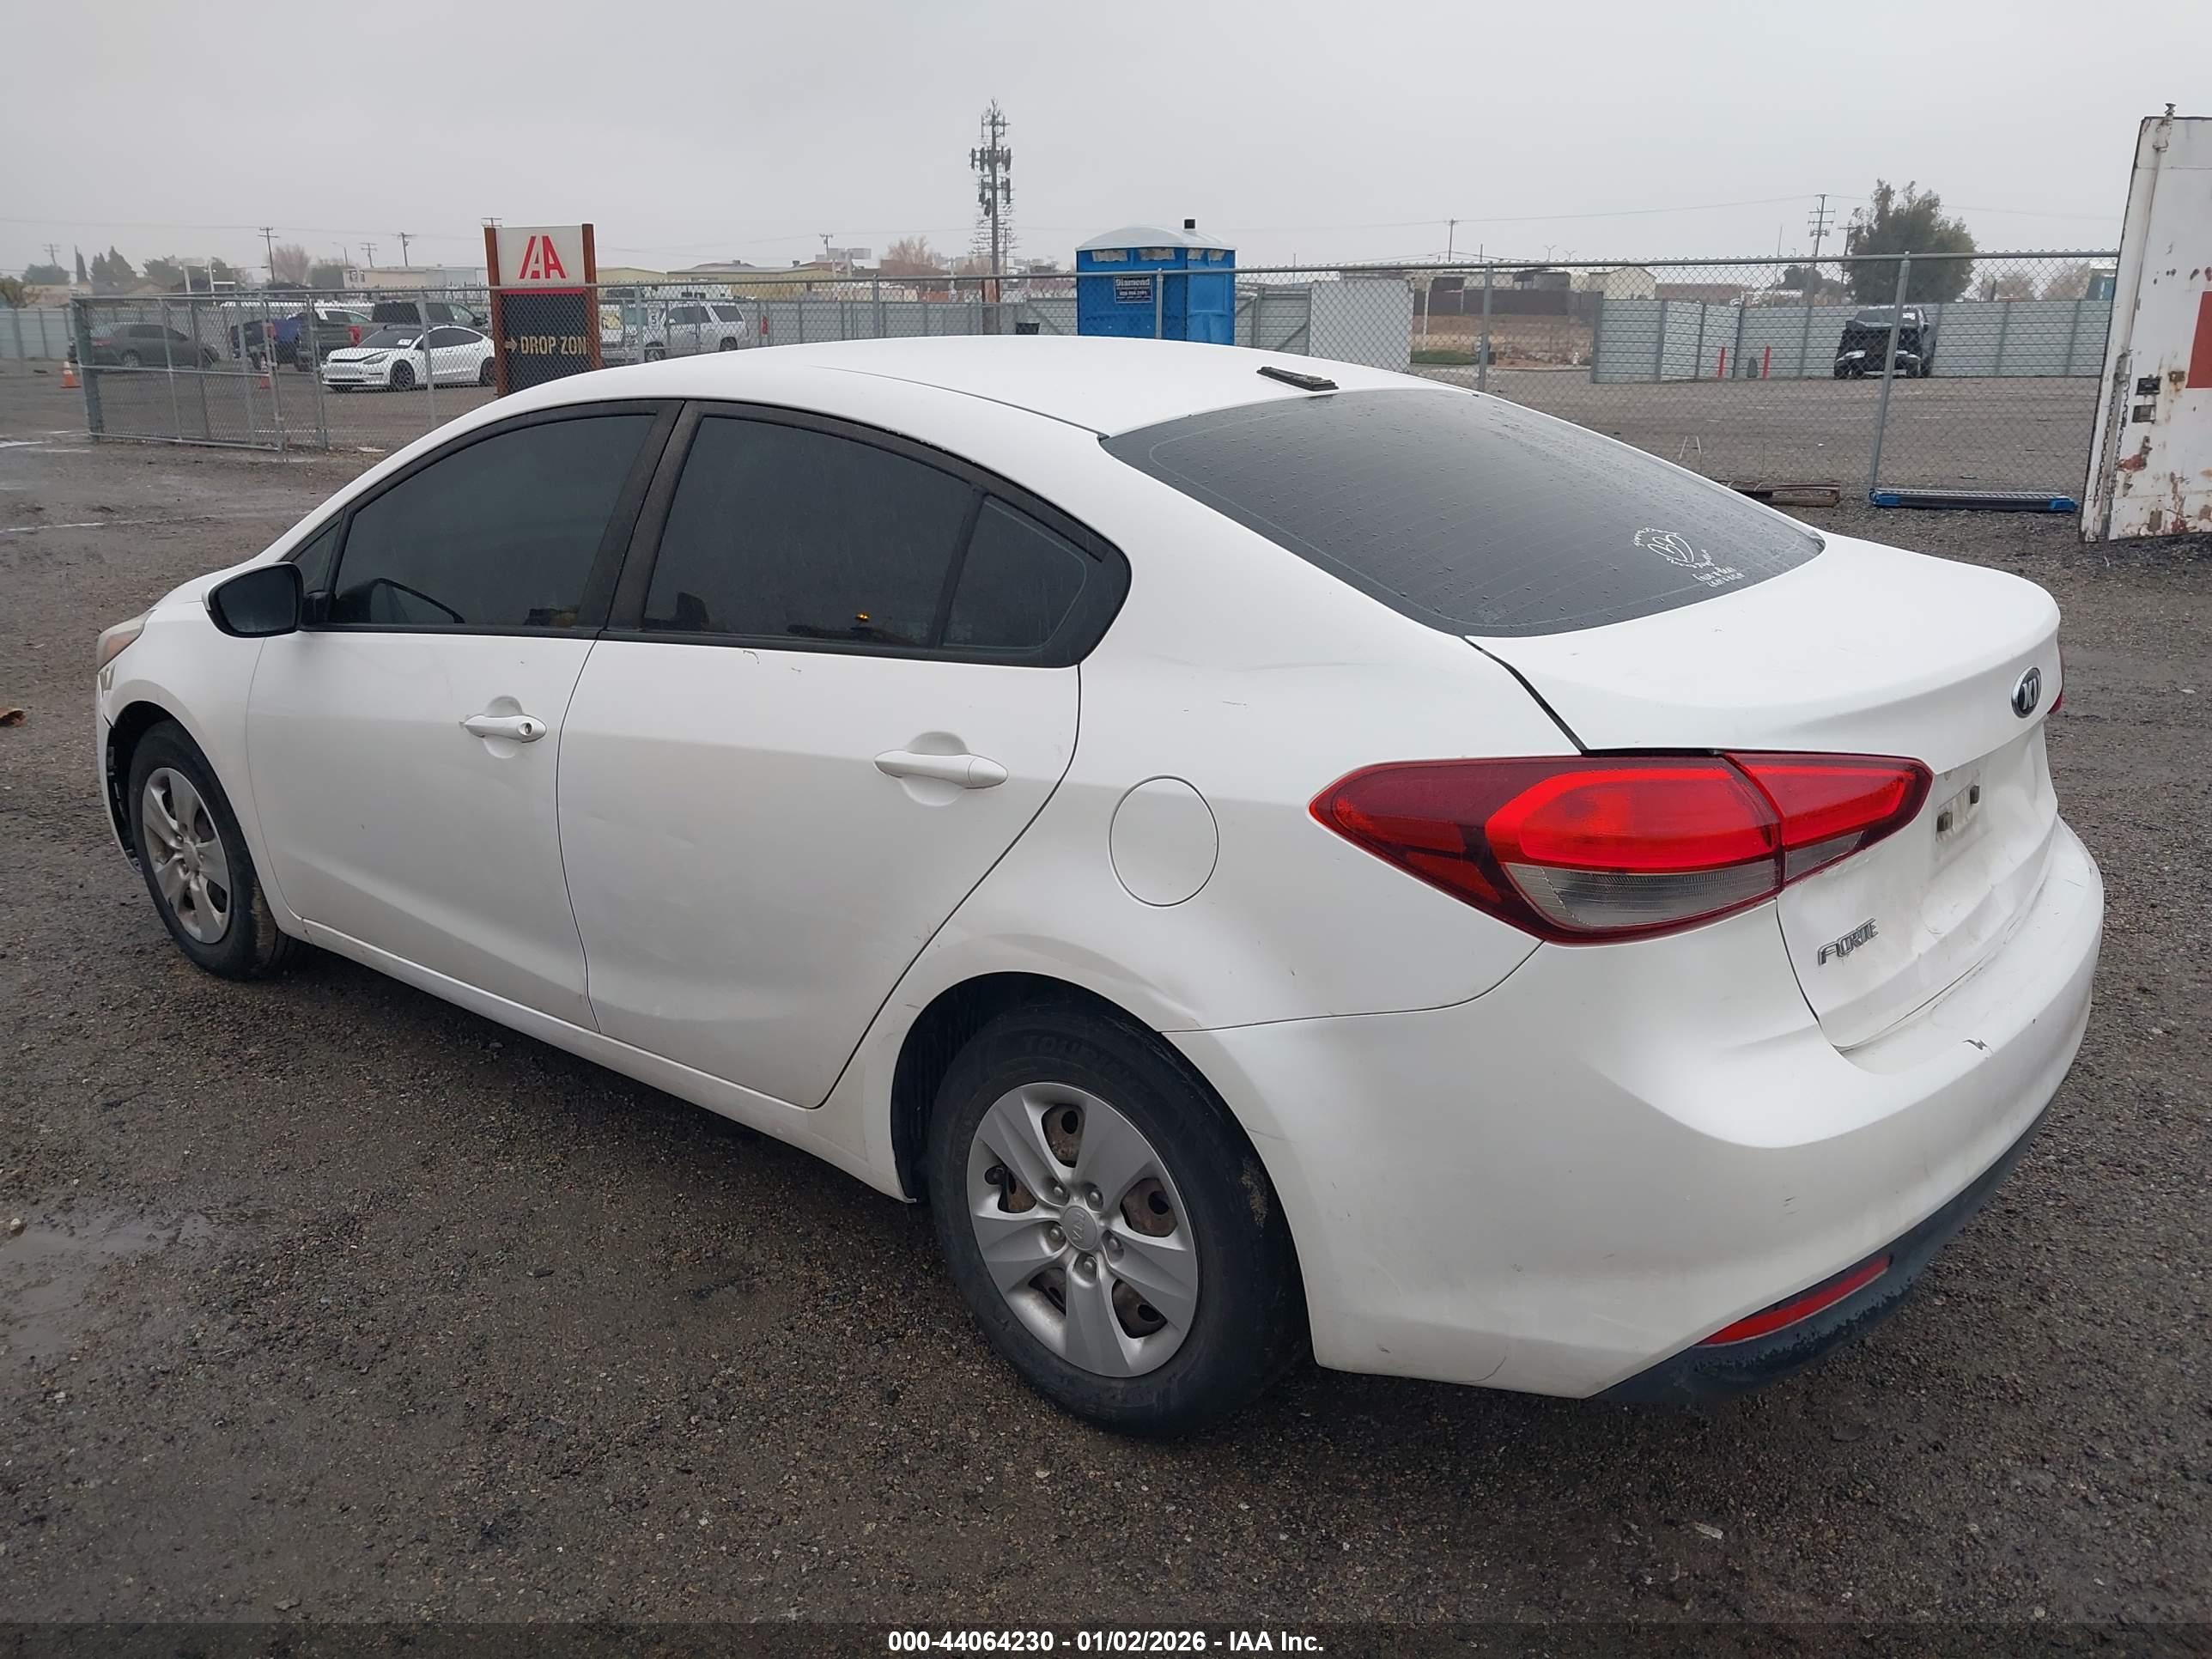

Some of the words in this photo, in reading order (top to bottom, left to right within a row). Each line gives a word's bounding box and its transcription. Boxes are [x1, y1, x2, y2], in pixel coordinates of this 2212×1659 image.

[520, 336, 556, 356] DROP
[560, 336, 590, 355] ZON
[1818, 918, 1878, 965] FORTE
